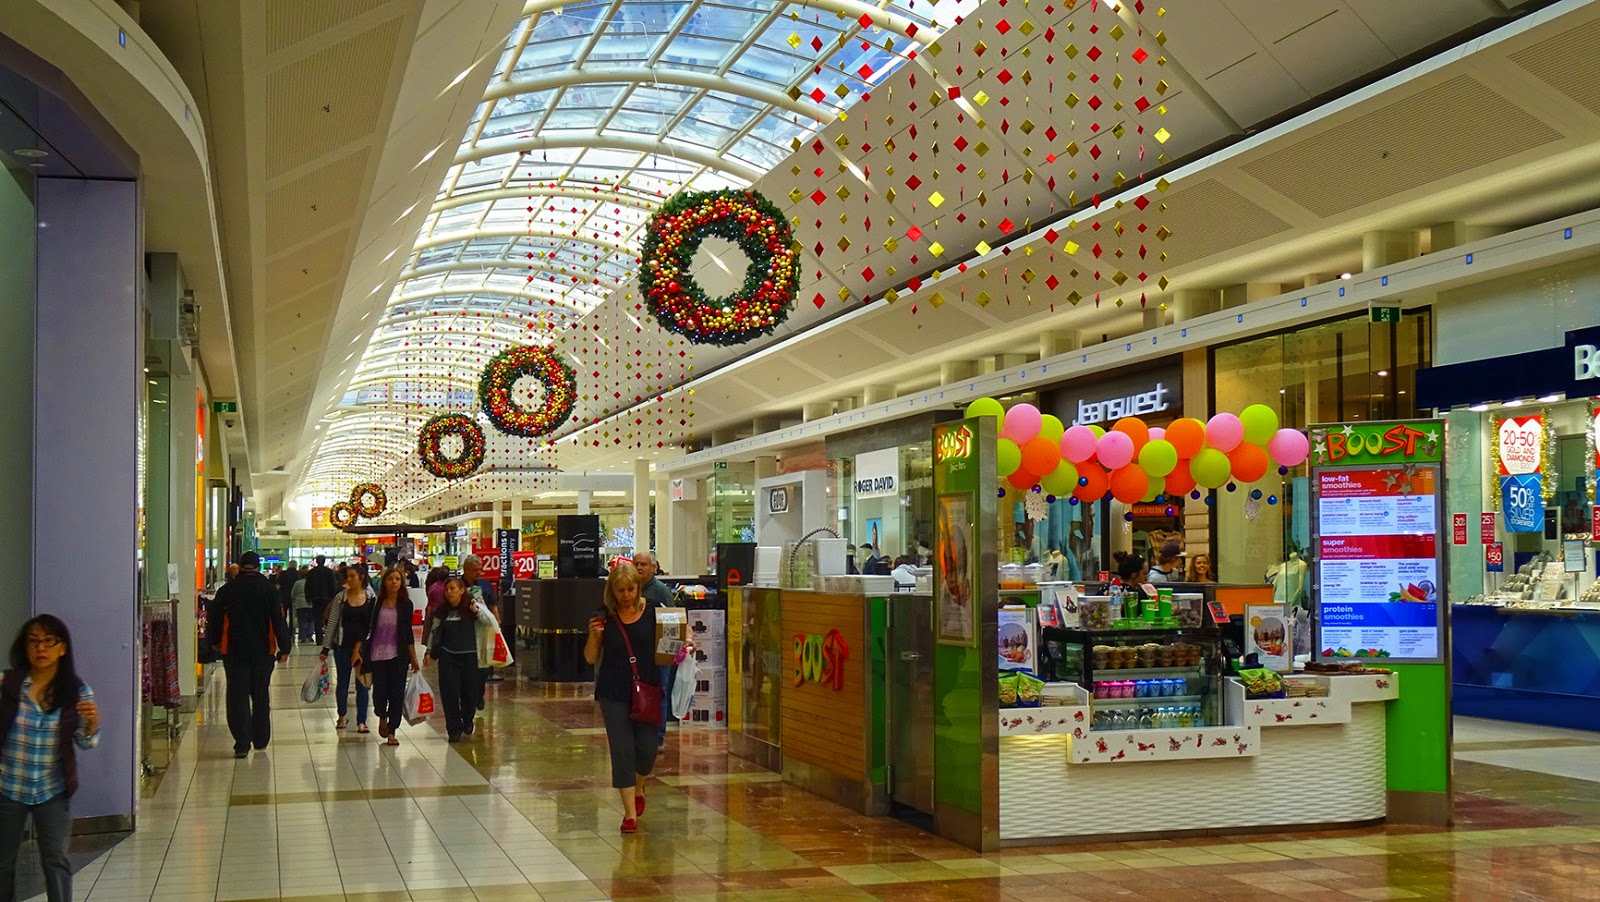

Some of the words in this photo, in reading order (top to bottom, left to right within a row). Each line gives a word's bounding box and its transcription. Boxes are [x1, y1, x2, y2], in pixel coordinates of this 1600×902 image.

[1072, 383, 1169, 425] Jeanswest
[934, 425, 973, 464] BOOST
[1326, 424, 1426, 462] BOOST
[1506, 446, 1521, 454] GOLD
[1522, 447, 1535, 455] AND
[1506, 453, 1535, 463] DIAMONDS
[854, 479, 873, 493] ROGER
[874, 475, 894, 491] DAVID
[1321, 475, 1350, 483] low-fat
[1321, 481, 1362, 489] smoothies
[1322, 539, 1345, 547] super
[514, 557, 534, 572] $20
[792, 628, 849, 692] BOOST
